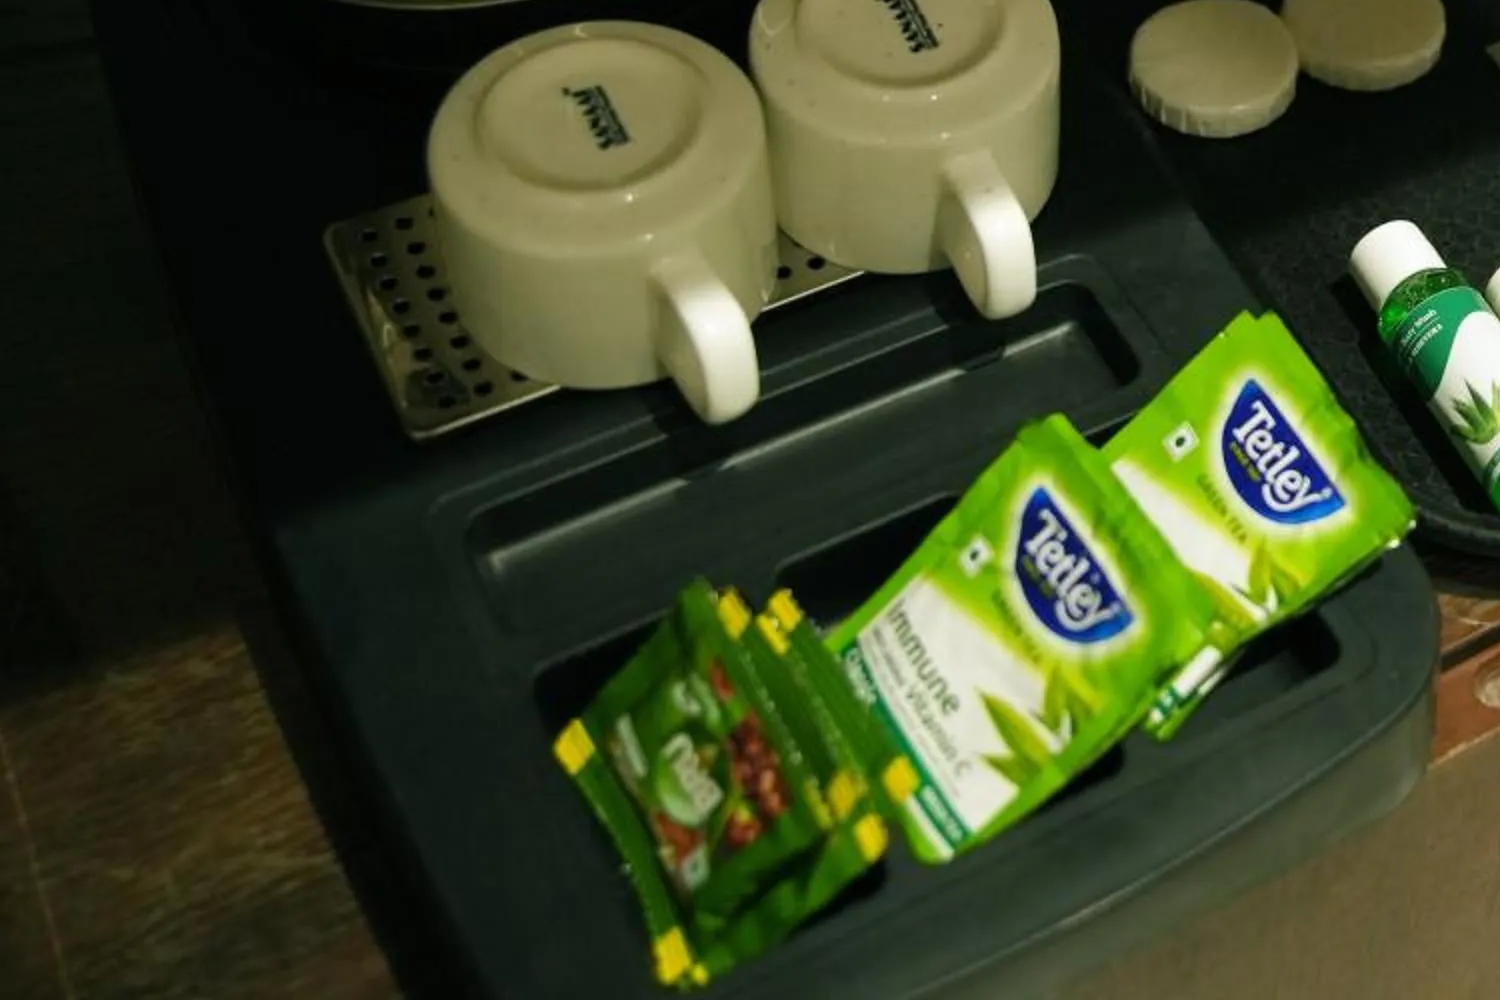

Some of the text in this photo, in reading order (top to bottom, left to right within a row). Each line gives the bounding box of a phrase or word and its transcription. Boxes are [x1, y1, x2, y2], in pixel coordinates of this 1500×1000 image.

[1231, 399, 1333, 513] Tetley
[1024, 509, 1122, 632] Tetley
[954, 759, 973, 779] C
